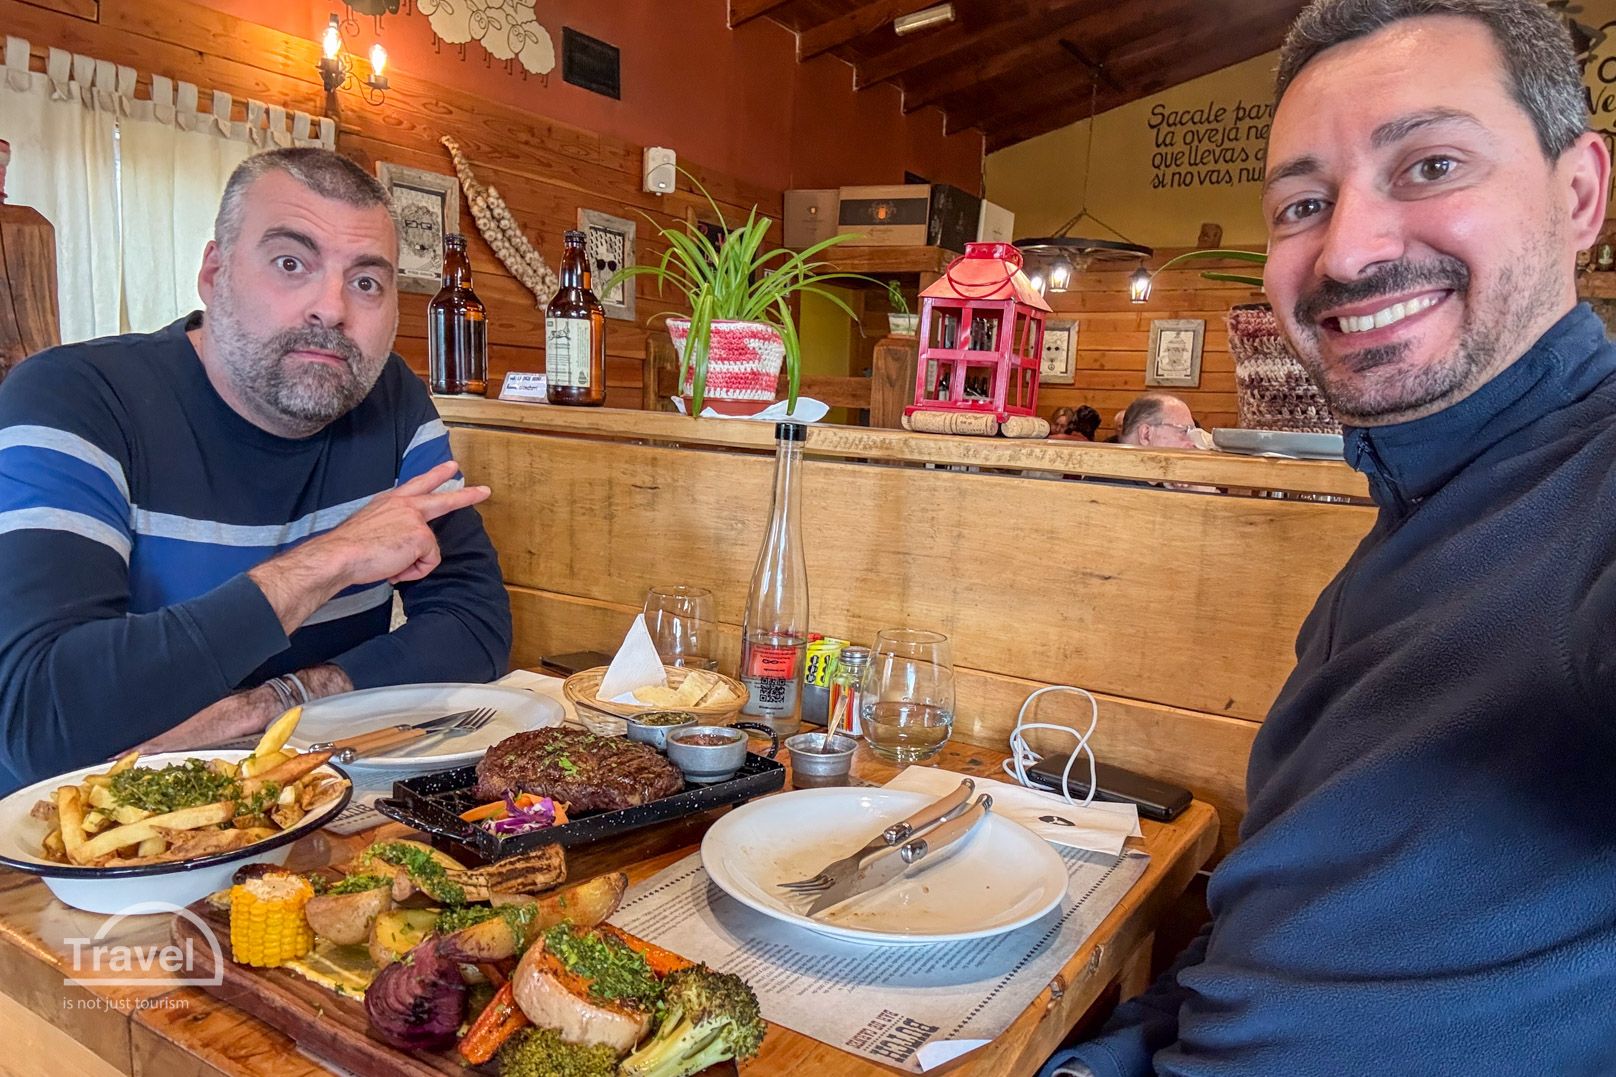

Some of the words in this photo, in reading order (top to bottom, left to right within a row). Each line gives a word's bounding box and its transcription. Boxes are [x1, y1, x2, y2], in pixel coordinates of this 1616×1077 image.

[1147, 101, 1227, 129] Sacale
[1183, 126, 1241, 148] oveja
[1188, 145, 1249, 167] llevas
[1170, 171, 1194, 188] no
[1238, 166, 1265, 184] nu
